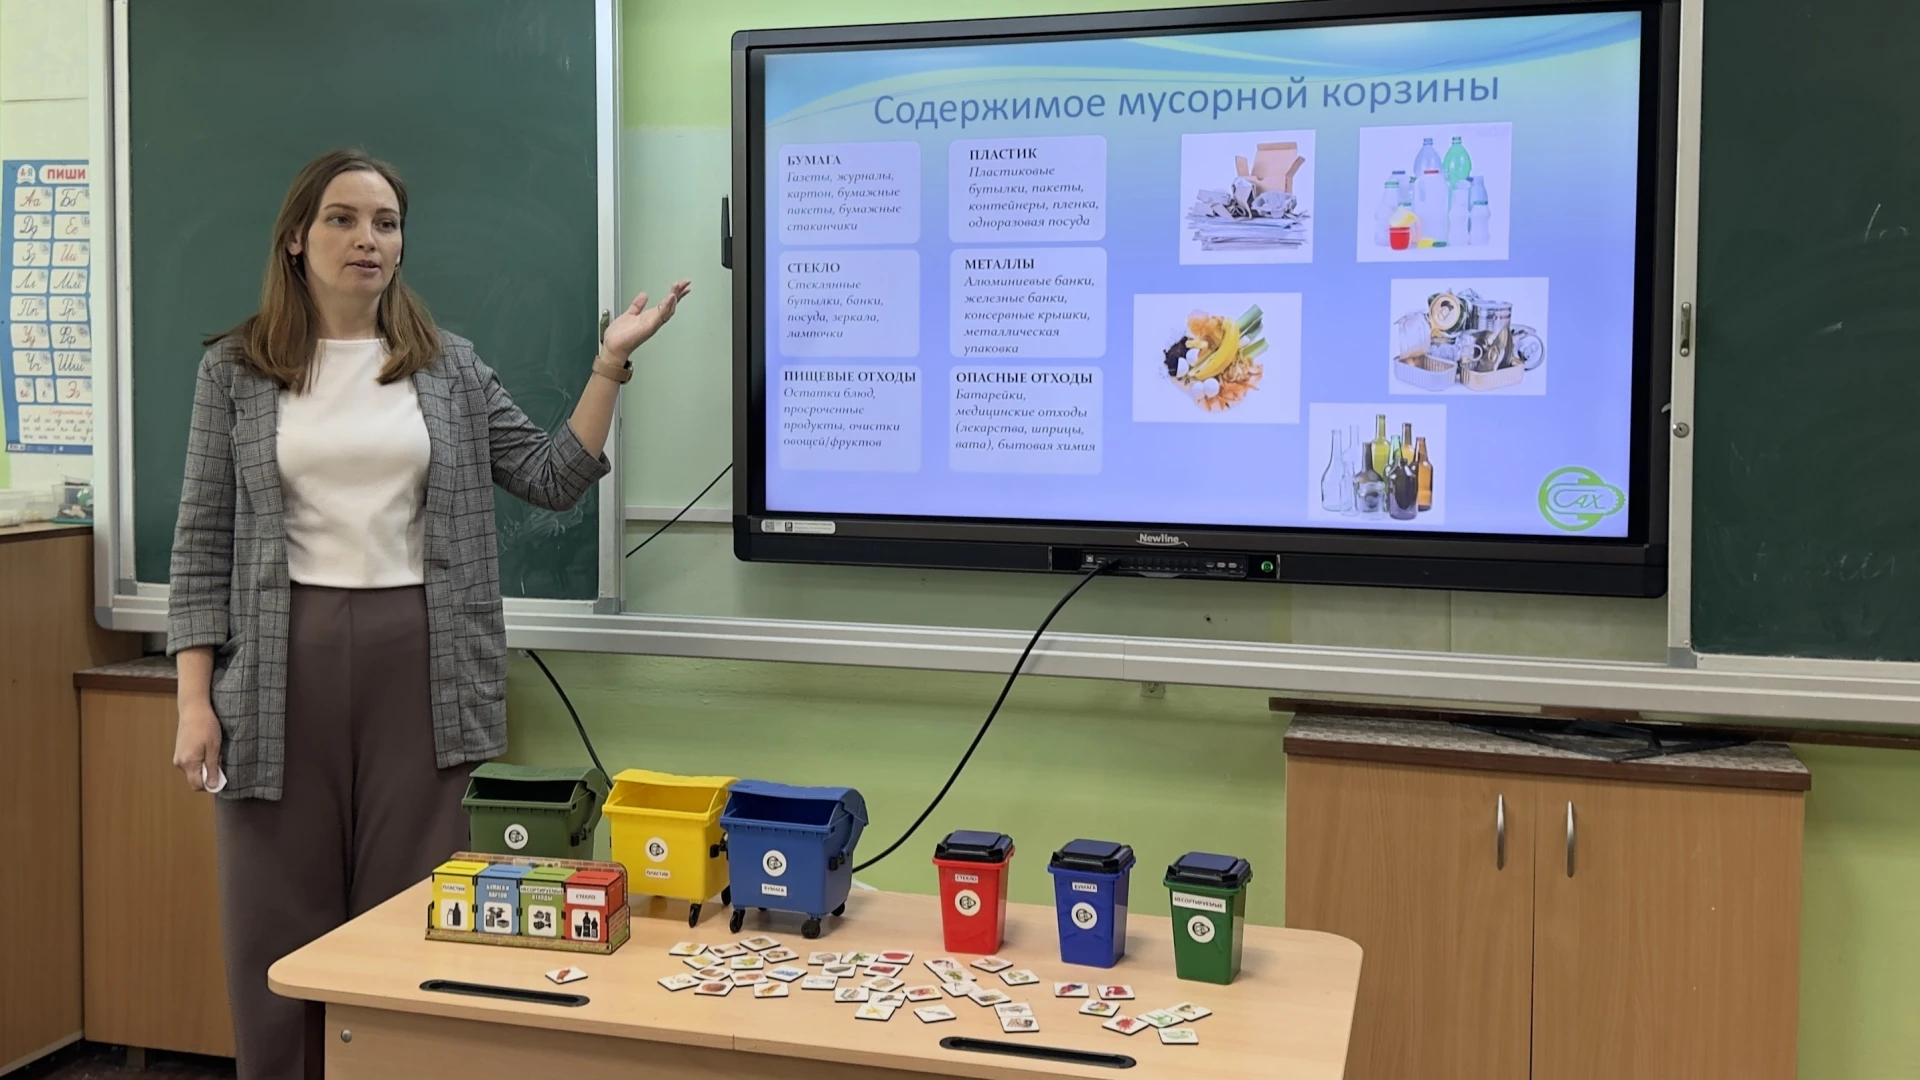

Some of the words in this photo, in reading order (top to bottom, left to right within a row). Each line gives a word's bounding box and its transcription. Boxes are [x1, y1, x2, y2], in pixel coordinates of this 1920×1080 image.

[874, 88, 1105, 129] Содержимое
[1118, 77, 1306, 119] мусорной
[1323, 76, 1499, 112] корзины
[788, 155, 841, 166] БУМАГА
[970, 149, 1037, 160] ПЛАСТИК
[47, 169, 85, 179] ПИШИ
[788, 172, 833, 183] Газеты,
[837, 171, 894, 183] журналы,
[969, 167, 1055, 177] Пластиковые
[788, 189, 834, 200] картон,
[838, 187, 900, 198] бумажные
[969, 183, 1028, 195] бутылки,
[1032, 183, 1084, 193] пакеты,
[788, 206, 836, 215] пакеты,
[839, 203, 902, 214] бумажные
[969, 199, 1049, 212] контейнеры,
[1053, 200, 1098, 210] пленка,
[788, 222, 858, 231] стаканчики
[969, 217, 1044, 230] одноразовая
[1048, 215, 1090, 229] посуда
[788, 263, 840, 273] СТЕКЛО
[965, 259, 1035, 270] МЕТАЛЛЫ
[788, 280, 861, 290] Стеклянные
[964, 277, 1051, 286] Алюминиевые
[1055, 275, 1094, 287] банки,
[788, 296, 842, 307] бутылки,
[846, 295, 883, 306] банки,
[964, 294, 1024, 303] железные
[1028, 292, 1067, 304] банки,
[788, 312, 829, 324] посуда,
[832, 313, 879, 323] зеркала,
[964, 311, 1034, 321] консервные
[1038, 311, 1090, 322] крышки,
[787, 329, 843, 340] лампочки
[964, 328, 1059, 337] металлическая
[964, 344, 1019, 356] упаковка
[784, 371, 854, 383] ПИЩЕВЫЕ
[858, 371, 916, 383] ОТХОДЫ
[956, 373, 1027, 383] ОПАСНЫЕ
[1031, 373, 1093, 385] ОТХОДЫ
[784, 388, 840, 398] Остатки
[844, 387, 876, 399] блюд,
[956, 389, 1026, 401] Батарейки,
[784, 405, 864, 417] просроченные
[956, 407, 1034, 419] медицинские
[1038, 406, 1087, 418] отходы
[784, 420, 845, 433] продукты,
[849, 422, 900, 432] очистки
[956, 423, 1027, 435] (лекарства,
[1031, 426, 1084, 436] шприцы,
[784, 437, 882, 450] овощей/фруктов
[956, 440, 994, 451] вата),
[998, 439, 1053, 451] бытовая
[1056, 442, 1095, 452] химия
[1139, 533, 1179, 543] Newline
